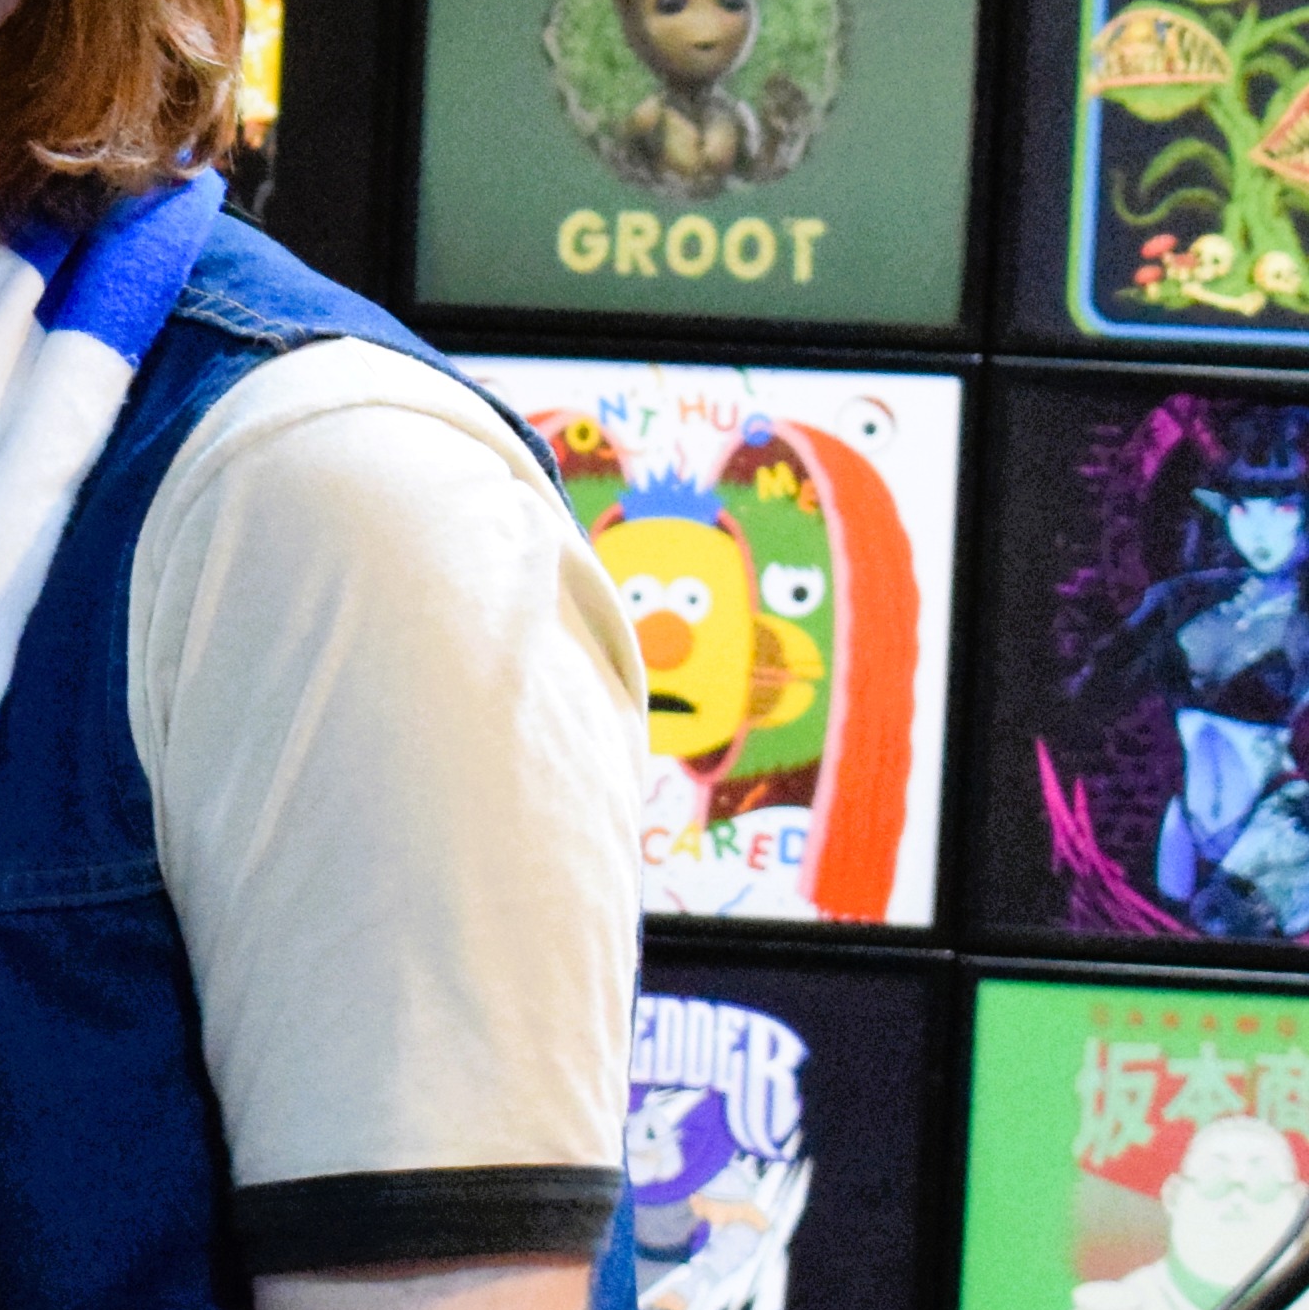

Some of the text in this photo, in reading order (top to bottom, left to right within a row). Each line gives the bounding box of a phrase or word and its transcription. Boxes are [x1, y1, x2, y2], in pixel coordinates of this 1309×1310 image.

[557, 208, 828, 285] GROOT
[641, 819, 809, 872] CARED
[630, 995, 811, 1162] EDDER
